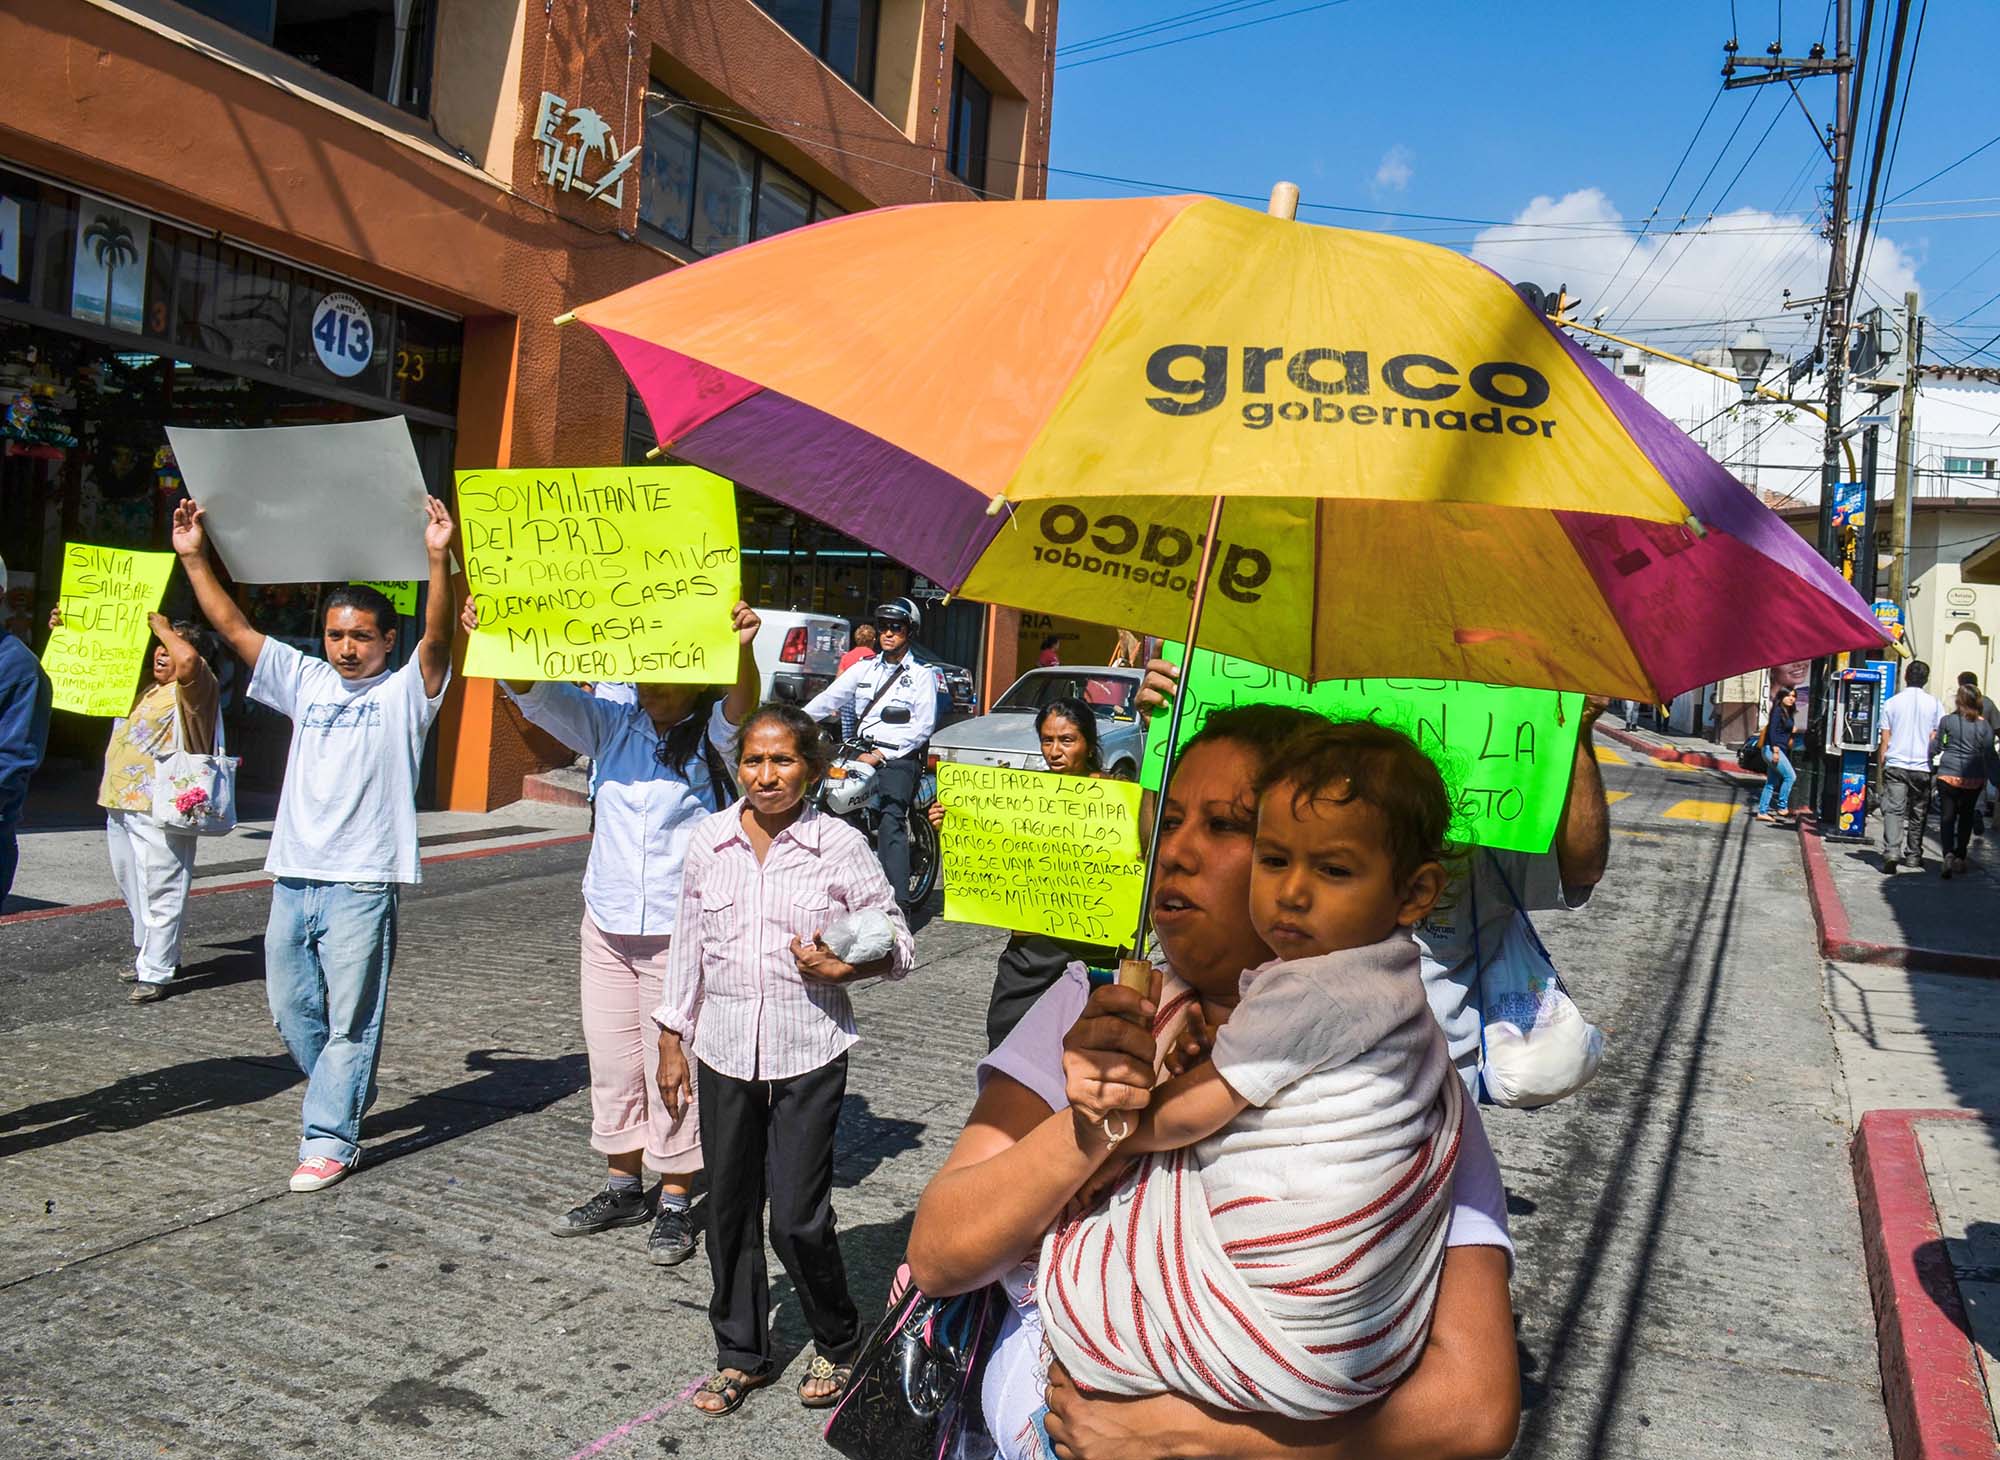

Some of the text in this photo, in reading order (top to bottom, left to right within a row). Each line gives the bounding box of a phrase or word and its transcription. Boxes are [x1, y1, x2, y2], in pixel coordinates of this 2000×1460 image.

[313, 308, 370, 362] 413
[395, 351, 424, 381] 23
[1145, 343, 1550, 416] graco
[1242, 397, 1557, 438] gobernador
[459, 475, 530, 520] SOY
[520, 557, 628, 585] PAGAS
[645, 549, 687, 570] MI
[690, 532, 739, 570] VOTO
[611, 575, 719, 607] CASAS
[61, 594, 144, 645] FUERA
[508, 627, 549, 665] MI
[1478, 712, 1536, 765] LA
[938, 787, 1034, 818] COMUNEROS
[1039, 796, 1056, 814] DE
[1000, 772, 1044, 790] PARA
[1056, 777, 1104, 799] LOS
[974, 816, 1004, 834] NOS
[1011, 818, 1075, 839] PAGUEN
[1083, 823, 1121, 845] LOS
[943, 851, 972, 868] QUE
[978, 854, 1000, 869] SE
[1002, 857, 1035, 875] VAYA
[945, 869, 961, 881] NO
[964, 870, 1007, 888] SOMOS
[944, 883, 1001, 902] SOMOS
